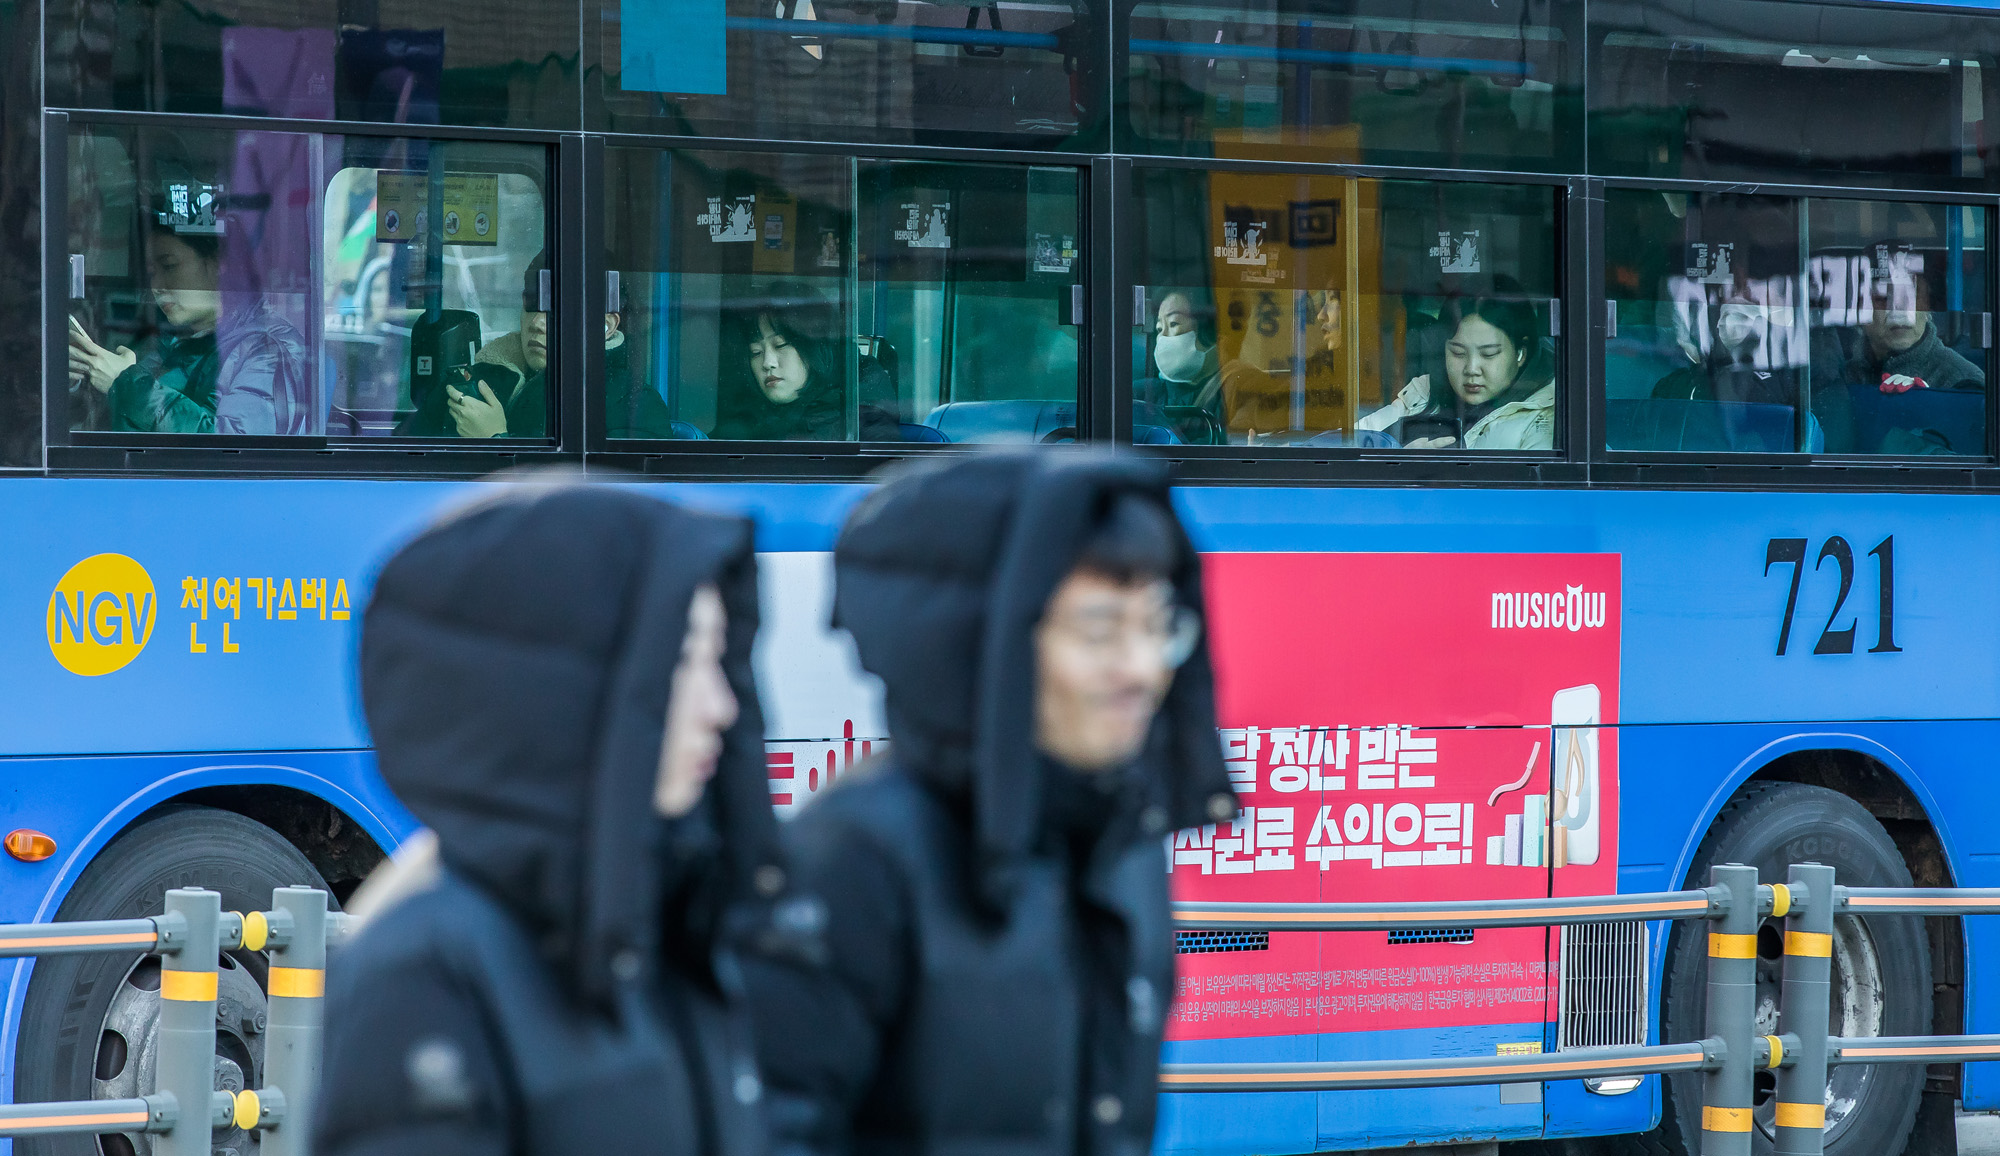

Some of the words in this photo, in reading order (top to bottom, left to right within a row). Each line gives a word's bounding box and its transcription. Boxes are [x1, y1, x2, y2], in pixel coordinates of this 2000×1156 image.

[55, 590, 153, 647] NGV
[180, 576, 350, 653] 천연가스버스
[1764, 534, 1903, 656] 721
[1268, 724, 1350, 793] 정산
[1357, 722, 1437, 790] 받는
[1304, 802, 1474, 871] 수익으로!
